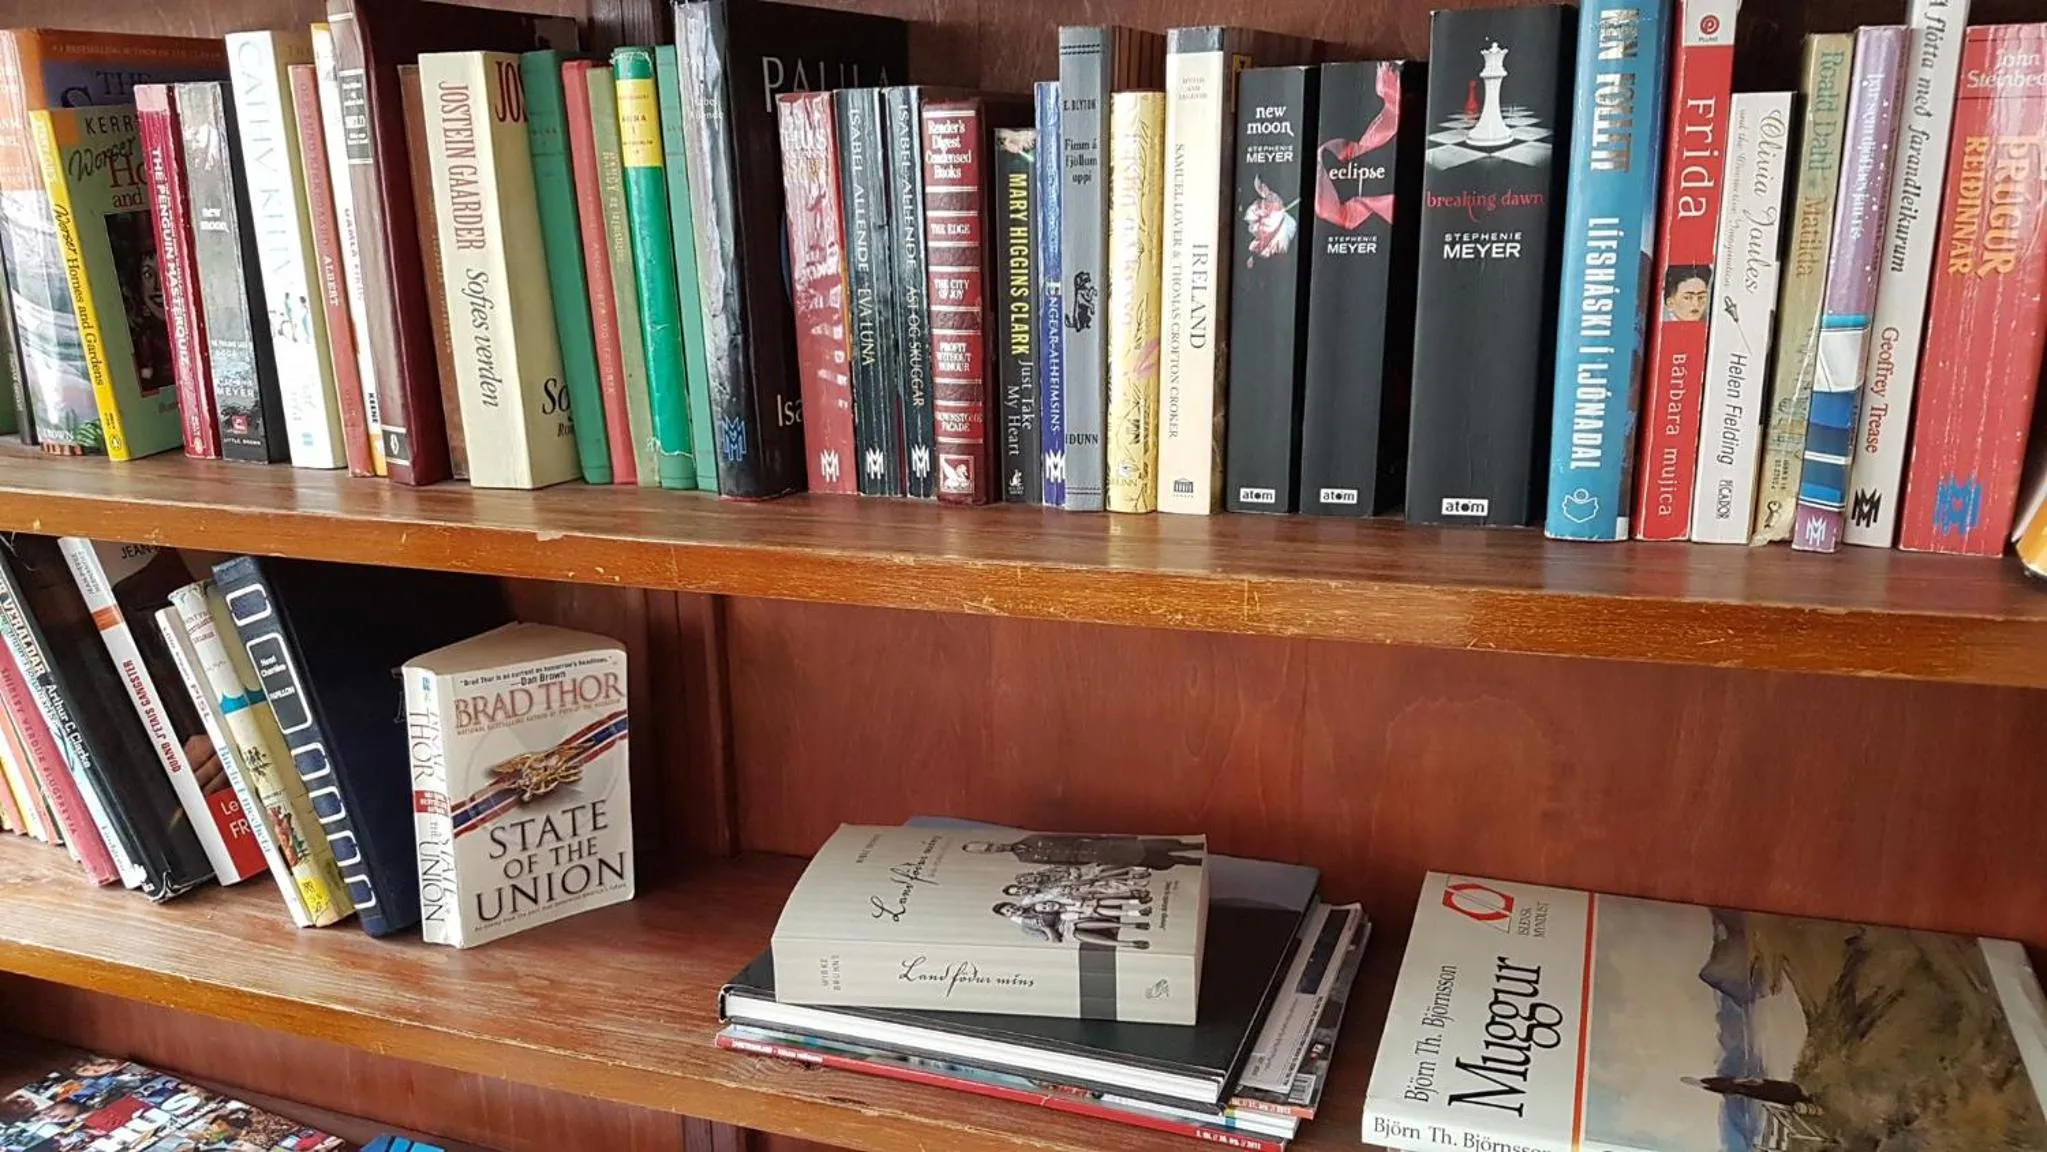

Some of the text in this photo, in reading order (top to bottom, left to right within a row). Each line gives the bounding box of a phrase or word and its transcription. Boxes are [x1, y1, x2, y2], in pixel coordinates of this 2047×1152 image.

[1967, 69, 2047, 88] Steinbec
[1996, 51, 2041, 70] John
[899, 104, 914, 167] ISABEL
[927, 120, 966, 134] Reader's
[1247, 121, 1294, 136] moon
[1256, 106, 1287, 118] new
[1807, 51, 1845, 172] Roald Dahl
[151, 146, 165, 182] THE
[438, 81, 486, 251] JOSTEIN GAARDER
[925, 149, 972, 164] Condensed
[931, 136, 961, 150] Digest
[1246, 152, 1294, 163] MEYER
[1678, 96, 1719, 219] Frida
[1891, 12, 1946, 273] flótta með farandleikurum
[933, 166, 962, 179] Books
[1329, 162, 1386, 190] eclipse
[112, 189, 144, 208] and
[156, 182, 178, 260] PENGUIN
[900, 173, 918, 268] ALLENDE
[1427, 190, 1545, 220] breaking dawn
[1743, 109, 1786, 295] Olivia Joules
[849, 108, 876, 367] ISABEL ALLENDE EVA LUNA
[1327, 242, 1377, 254] MEYER
[1443, 242, 1521, 259] MEYER
[1444, 232, 1523, 242] STEPHENIE
[1796, 195, 1828, 279] Matilda
[65, 257, 85, 303] Homes
[322, 254, 339, 307] ALBERT
[1008, 174, 1029, 355] MARY HIGGINS CLARK
[1581, 217, 1624, 337] LÍFSHÁSKI
[77, 300, 95, 330] and
[1169, 264, 1182, 322] THOMAS
[1190, 244, 1209, 350] IRELAND
[82, 331, 105, 386] Gardens
[461, 267, 503, 408] Sofies verden
[1018, 360, 1036, 430] Just Take
[1168, 389, 1180, 439] CROKER
[1717, 352, 1748, 467] Helen Fielding
[1865, 326, 1899, 453] Geoffrey Trease
[1003, 386, 1021, 456] My Heart
[1570, 363, 1613, 470] LJÓNADAL
[1240, 490, 1274, 501] atom
[1322, 491, 1355, 502] atom
[1657, 447, 1678, 517] mujica
[1716, 479, 1734, 520] PICADOR
[1445, 500, 1485, 514] atom
[3, 601, 46, 678] VERALDAR
[122, 659, 149, 707] GANGSTER
[454, 671, 626, 729] BRAD THOR
[540, 670, 566, 682] Brown
[44, 683, 69, 722] Arthur
[65, 721, 76, 733] C
[70, 731, 92, 770] Clarke
[162, 743, 182, 774] QUAND
[409, 707, 435, 782] THOR
[220, 801, 239, 815] Le
[489, 800, 609, 860] STATE
[418, 839, 445, 922] UNION
[504, 836, 599, 880] OF THE
[476, 851, 628, 922] UNION
[899, 955, 951, 982] Land
[1404, 964, 1458, 1103] Björn Th. Björnsson
[1447, 956, 1564, 1118] Muggur
[1374, 1117, 1458, 1147] Björn Th.
